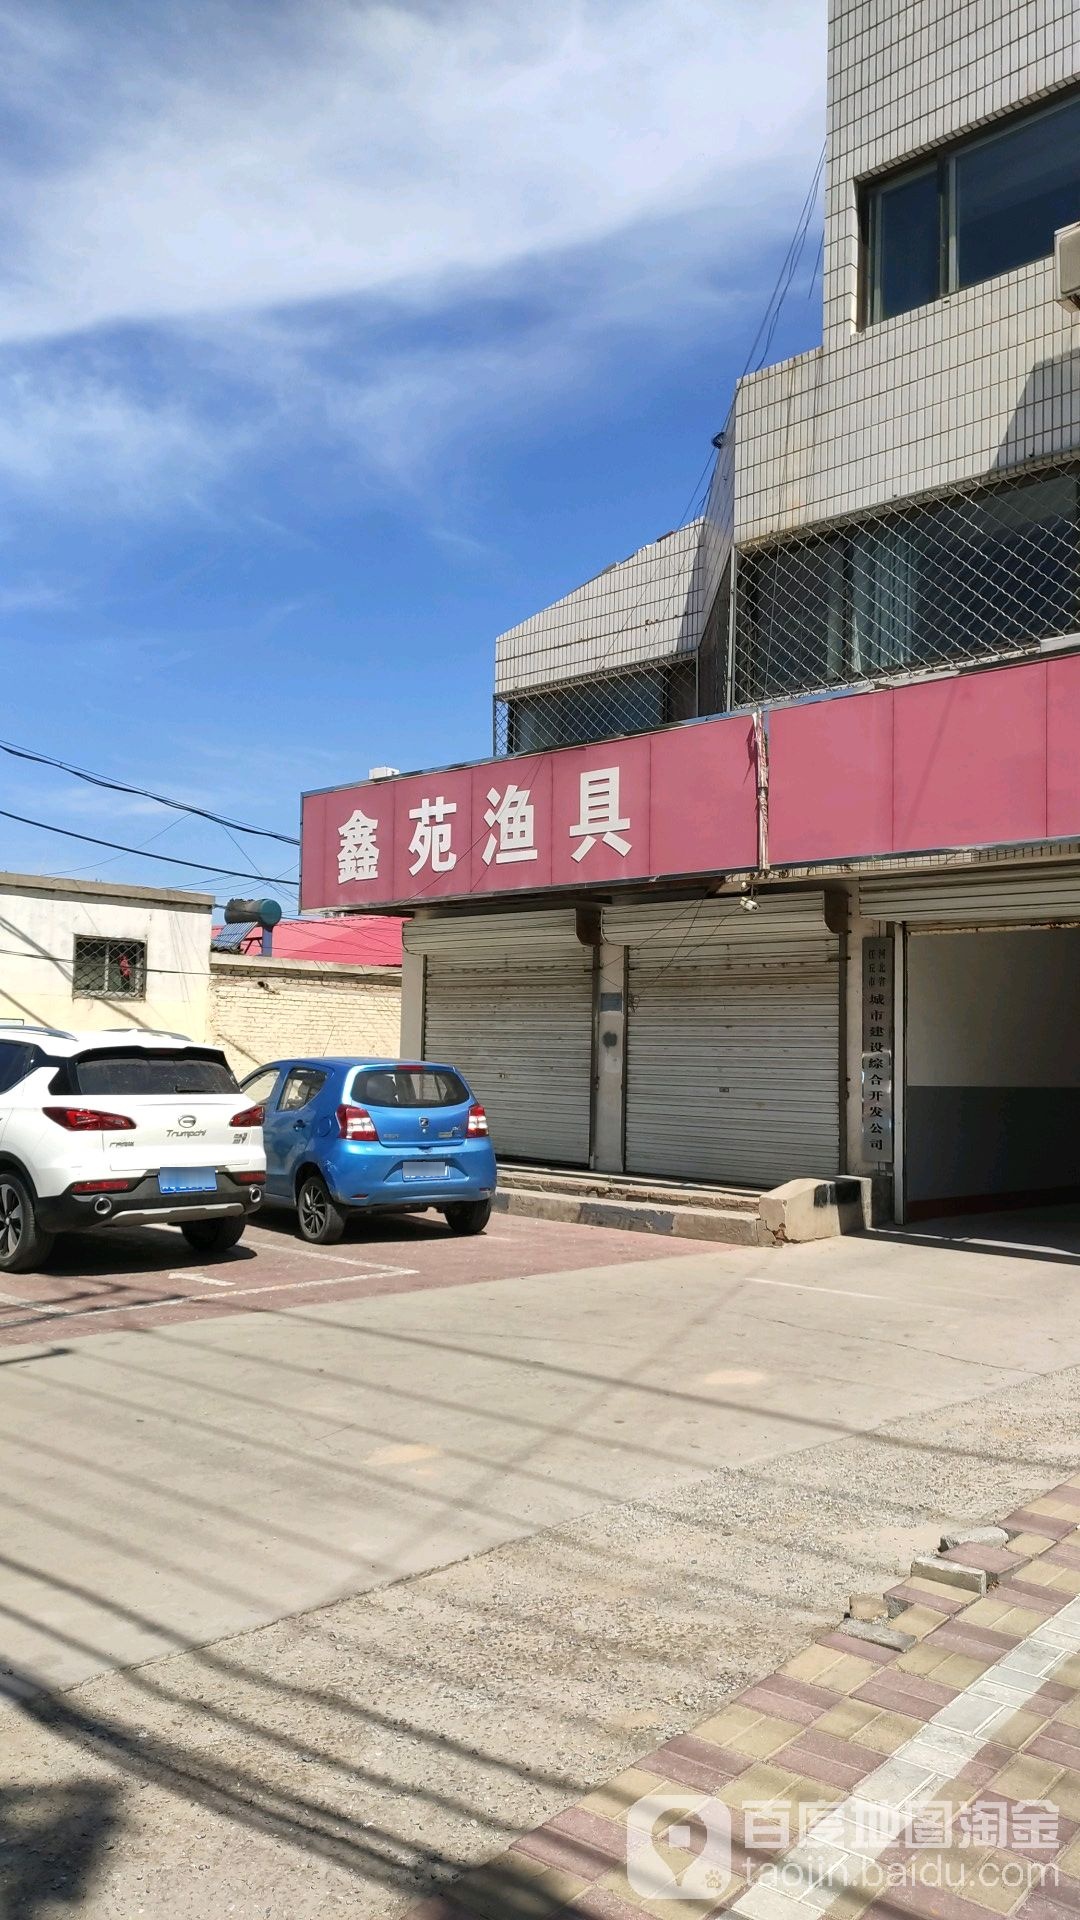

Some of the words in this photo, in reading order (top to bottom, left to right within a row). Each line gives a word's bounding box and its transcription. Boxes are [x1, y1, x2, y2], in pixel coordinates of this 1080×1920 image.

[337, 766, 632, 884] 鑫苑渔具
[868, 993, 884, 1151] 城市建设综合开发公司
[166, 1129, 207, 1138] Trumpchi
